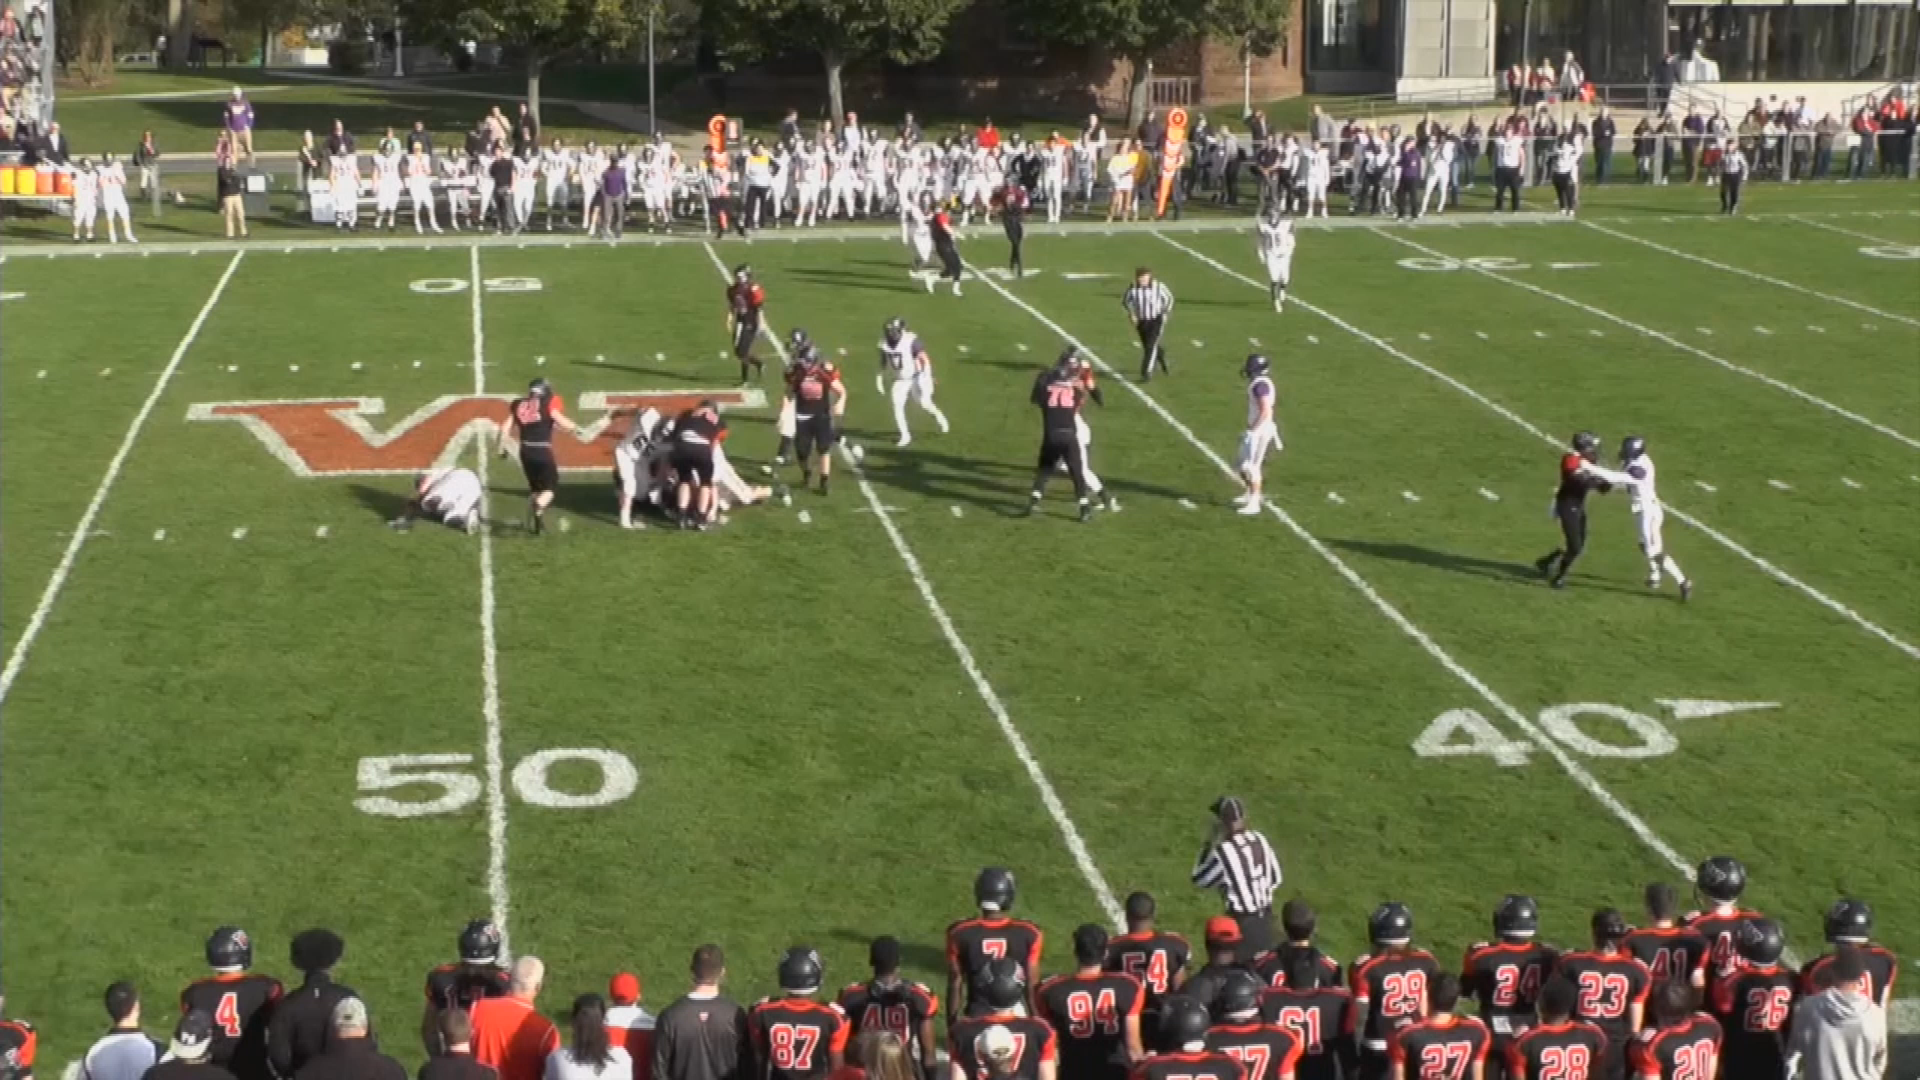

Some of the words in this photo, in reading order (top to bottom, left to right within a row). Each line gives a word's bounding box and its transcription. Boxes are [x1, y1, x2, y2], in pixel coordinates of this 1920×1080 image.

[408, 278, 543, 292] 50
[1411, 702, 1679, 767] 40
[353, 747, 638, 819] 50
[1122, 948, 1168, 994] 54
[1493, 963, 1541, 1007] 24
[1650, 947, 1688, 981] 41
[215, 991, 242, 1037] 4
[1067, 988, 1119, 1038] 94
[1381, 968, 1427, 1017] 29
[1578, 971, 1630, 1018] 23
[1744, 985, 1793, 1032] 26
[769, 1023, 821, 1070] 87
[1420, 1040, 1472, 1080] 27
[1539, 1043, 1590, 1080] 28
